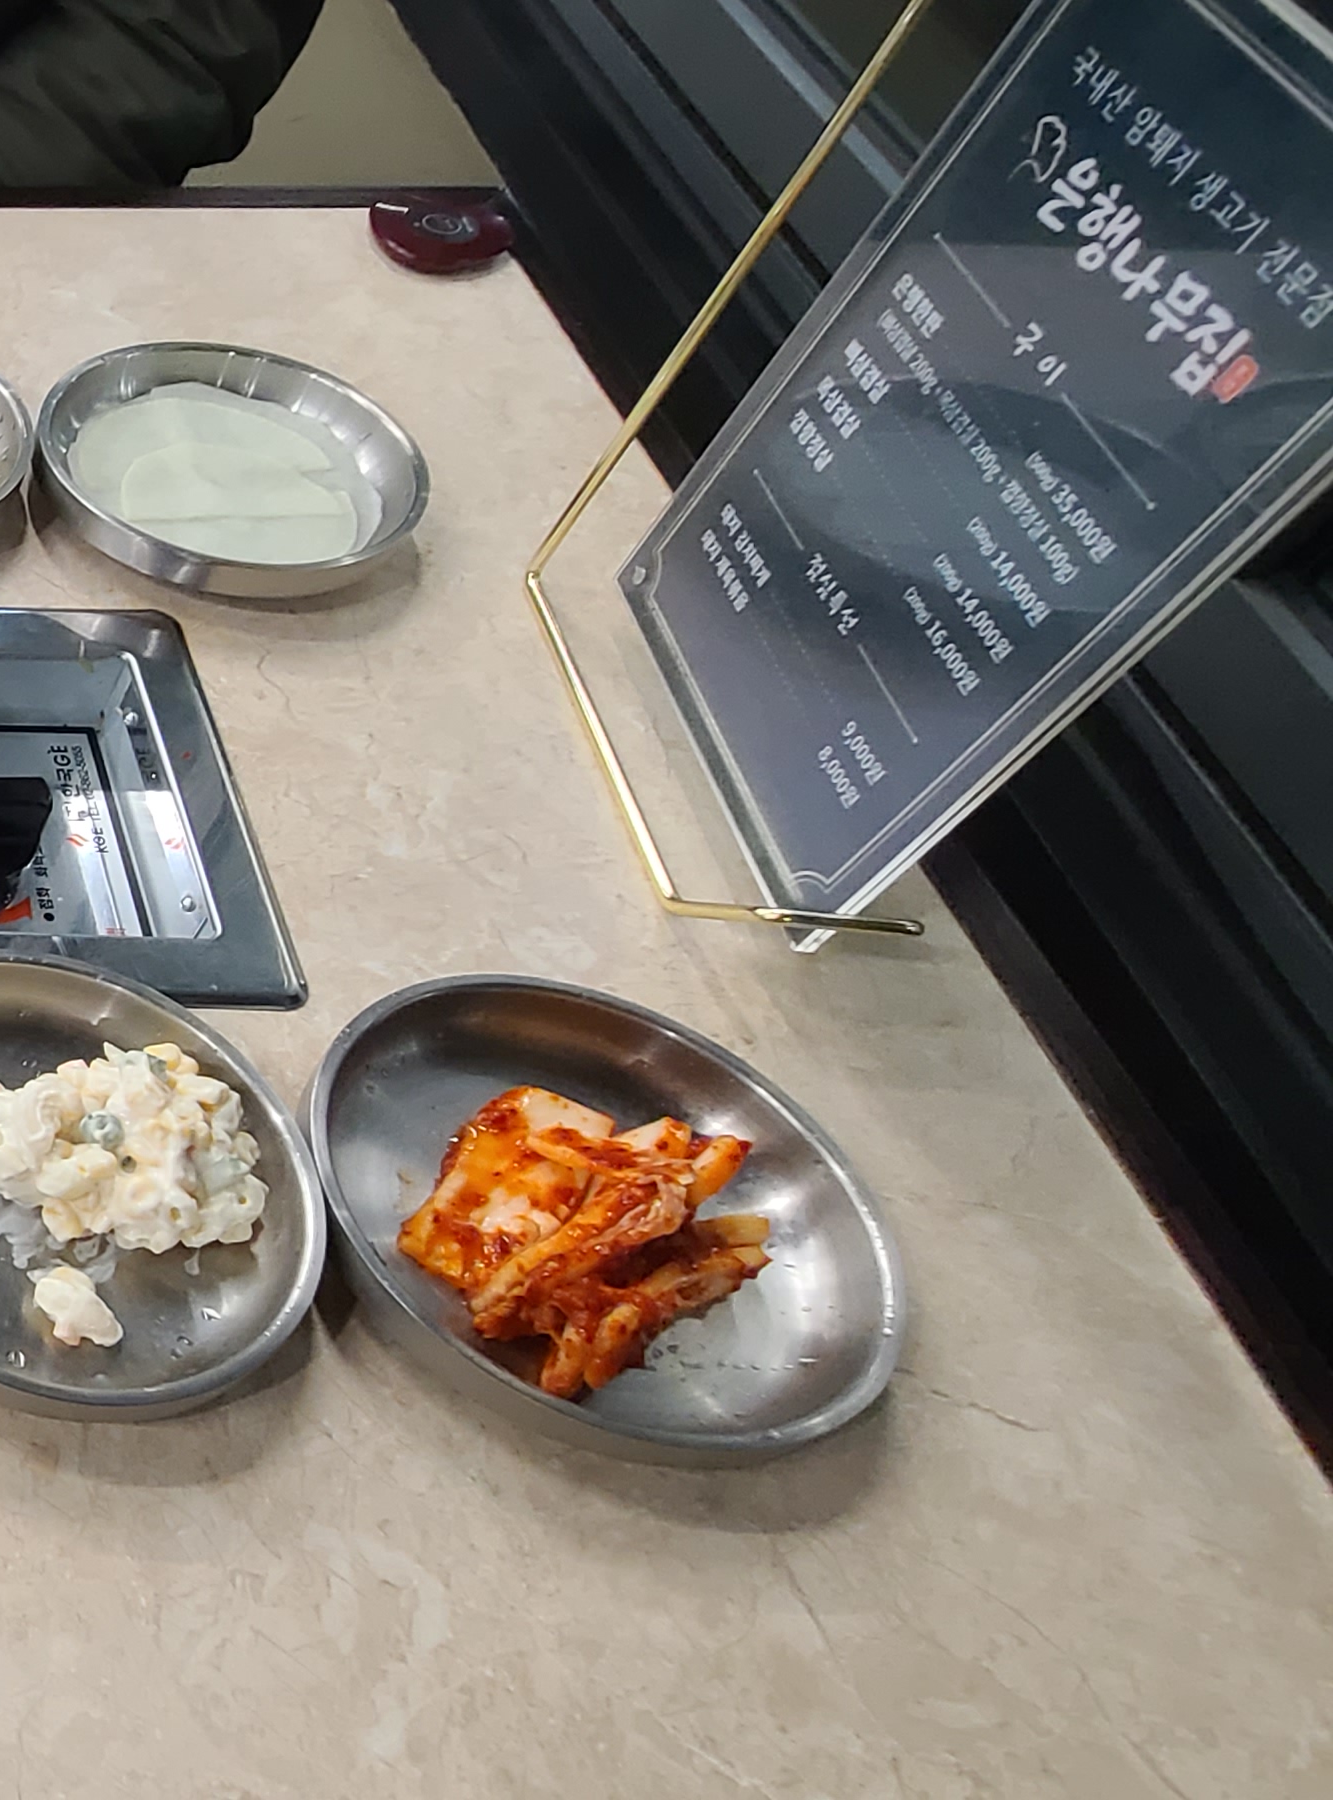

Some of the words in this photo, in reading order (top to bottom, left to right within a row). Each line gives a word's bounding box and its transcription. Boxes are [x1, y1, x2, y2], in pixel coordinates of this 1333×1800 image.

[1072, 46, 1134, 122] 국내산
[1124, 106, 1201, 186] 암돼지
[1189, 172, 1271, 254] 생고기
[1256, 238, 1333, 329] 전문점
[1037, 158, 1251, 395] 은행나무집
[1051, 483, 1118, 564] 35,000원
[805, 553, 860, 636] 점심특선
[955, 587, 1014, 664] 14,000원
[990, 551, 1051, 628] 14,000원
[700, 529, 722, 562] 돼지
[818, 745, 861, 809] 8,000원
[720, 503, 742, 537] 돼지
[841, 720, 887, 786] 9,000원
[925, 620, 981, 696] 16,000원
